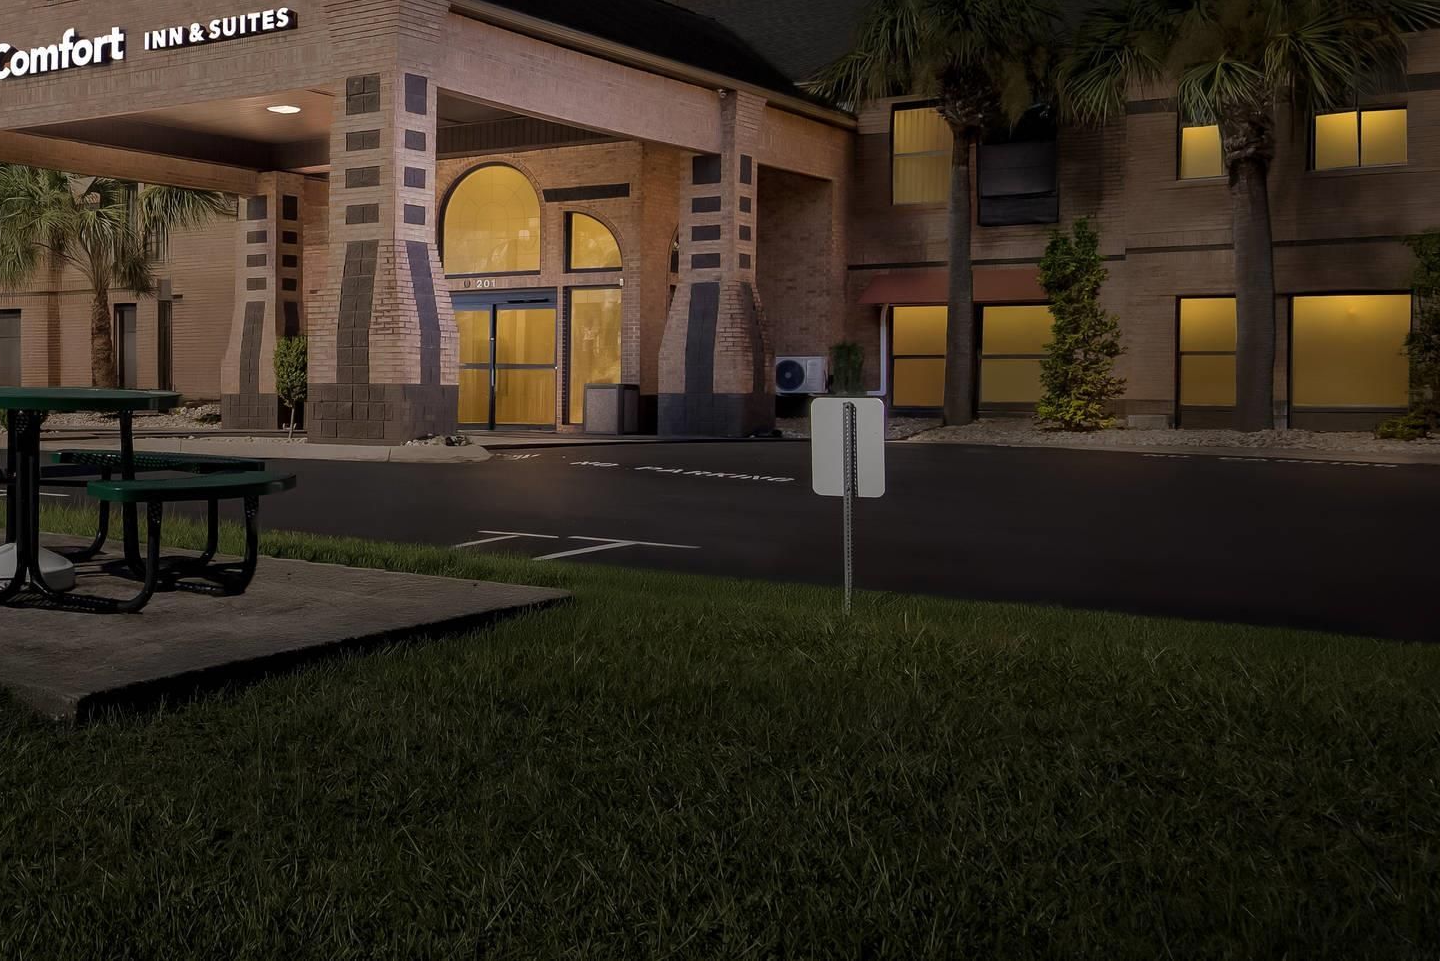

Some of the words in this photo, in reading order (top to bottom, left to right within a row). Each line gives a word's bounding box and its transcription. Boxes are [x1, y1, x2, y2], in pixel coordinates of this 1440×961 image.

[143, 25, 184, 51] INN
[188, 22, 206, 43] &
[208, 6, 291, 40] SUITES
